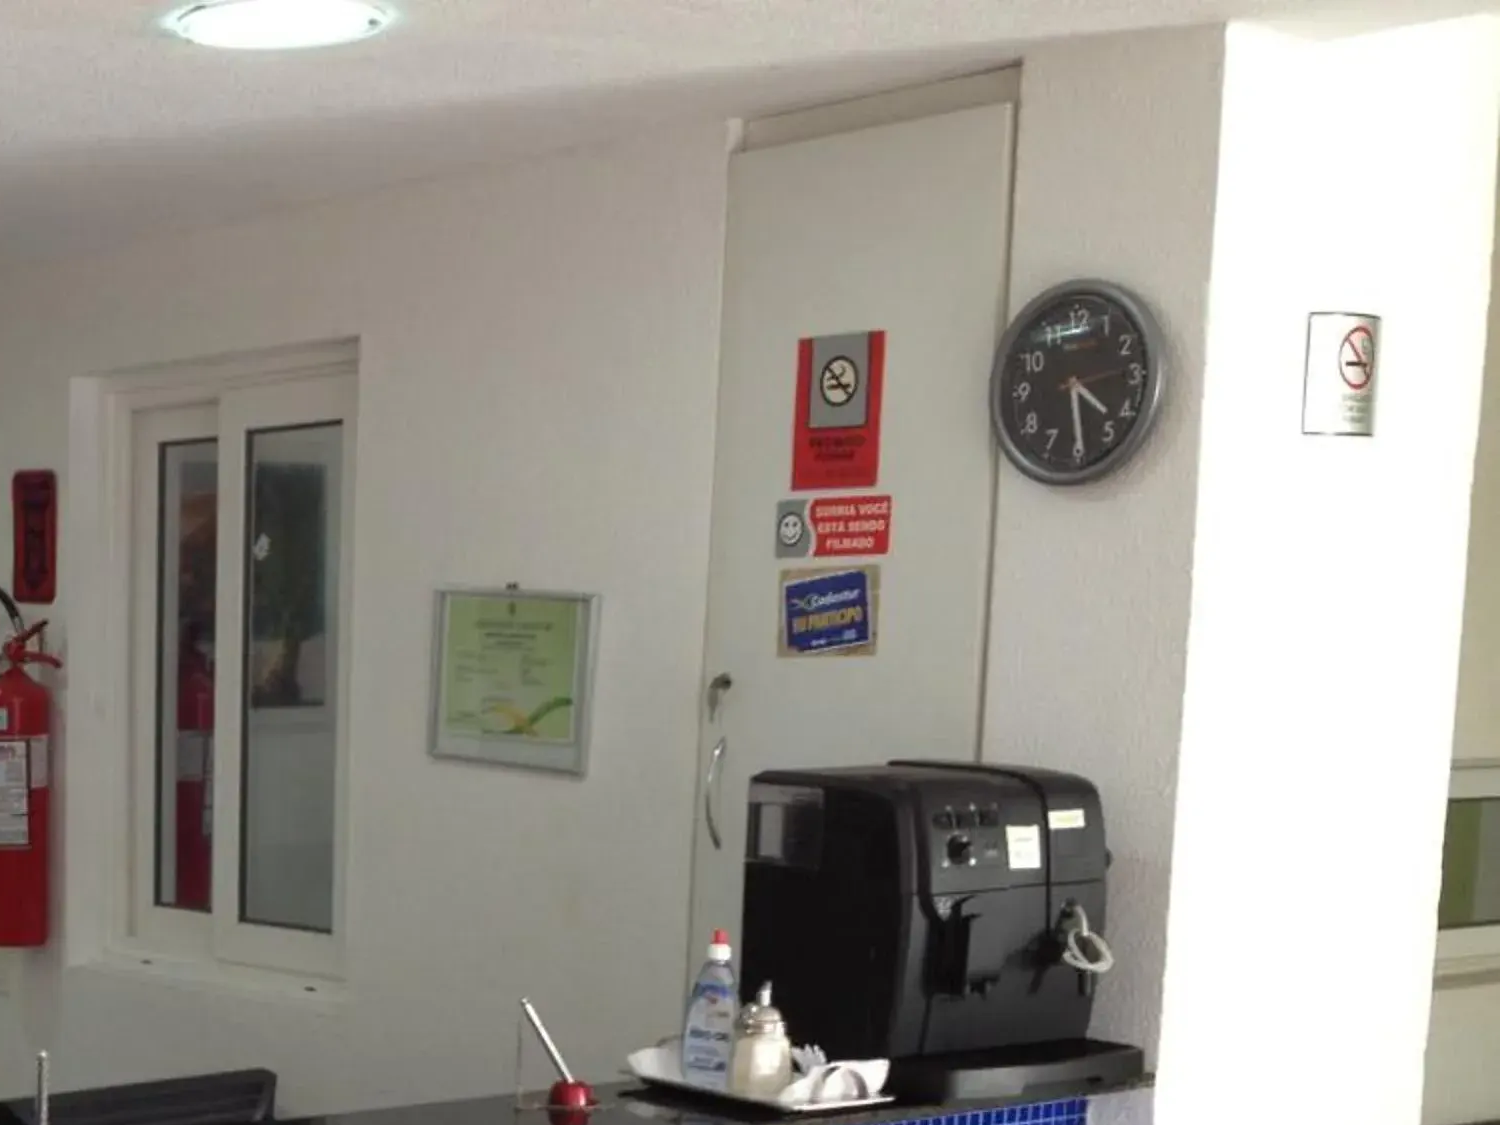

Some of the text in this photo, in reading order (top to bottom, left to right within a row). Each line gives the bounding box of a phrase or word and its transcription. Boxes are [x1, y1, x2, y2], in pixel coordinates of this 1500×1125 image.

[1069, 308, 1090, 330] 12
[1102, 314, 1110, 336] 1
[1044, 325, 1062, 347] 11
[1118, 335, 1134, 356] 2
[1020, 351, 1044, 373] 10
[1129, 363, 1142, 385] 3
[1017, 382, 1031, 403] 9
[1120, 398, 1137, 417] 4
[1024, 411, 1038, 434] 8
[1102, 421, 1115, 443] 5
[1045, 428, 1059, 450] 7
